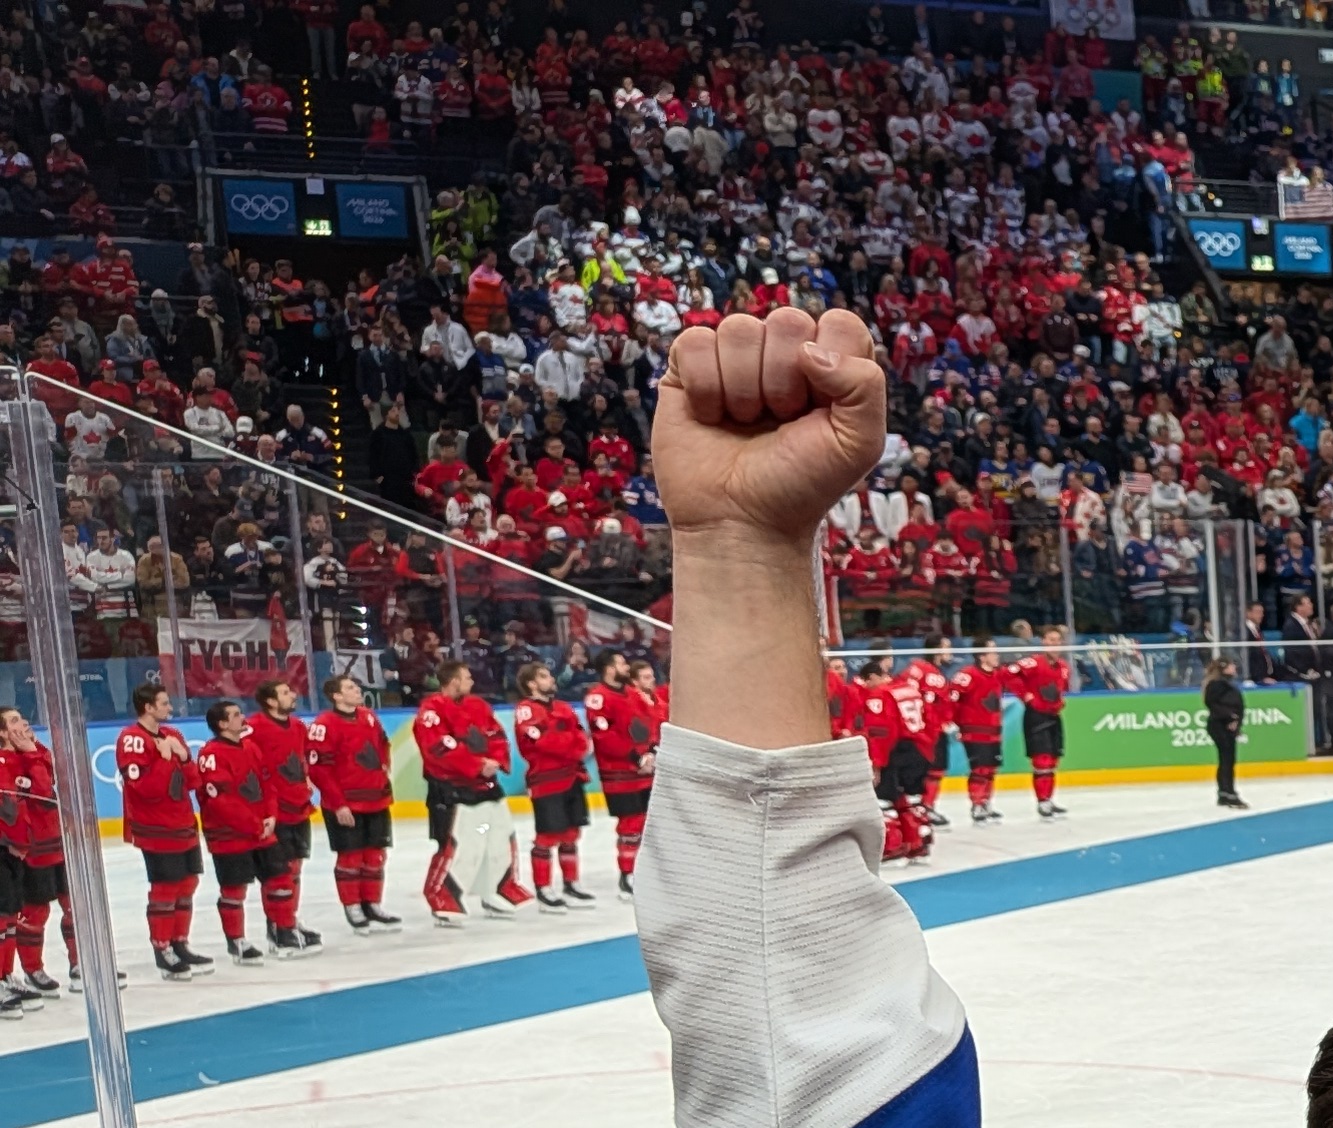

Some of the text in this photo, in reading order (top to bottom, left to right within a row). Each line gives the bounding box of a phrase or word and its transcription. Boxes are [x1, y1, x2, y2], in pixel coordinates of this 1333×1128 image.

[1093, 708, 1292, 731] MILANO CTINA
[123, 735, 145, 754] 20
